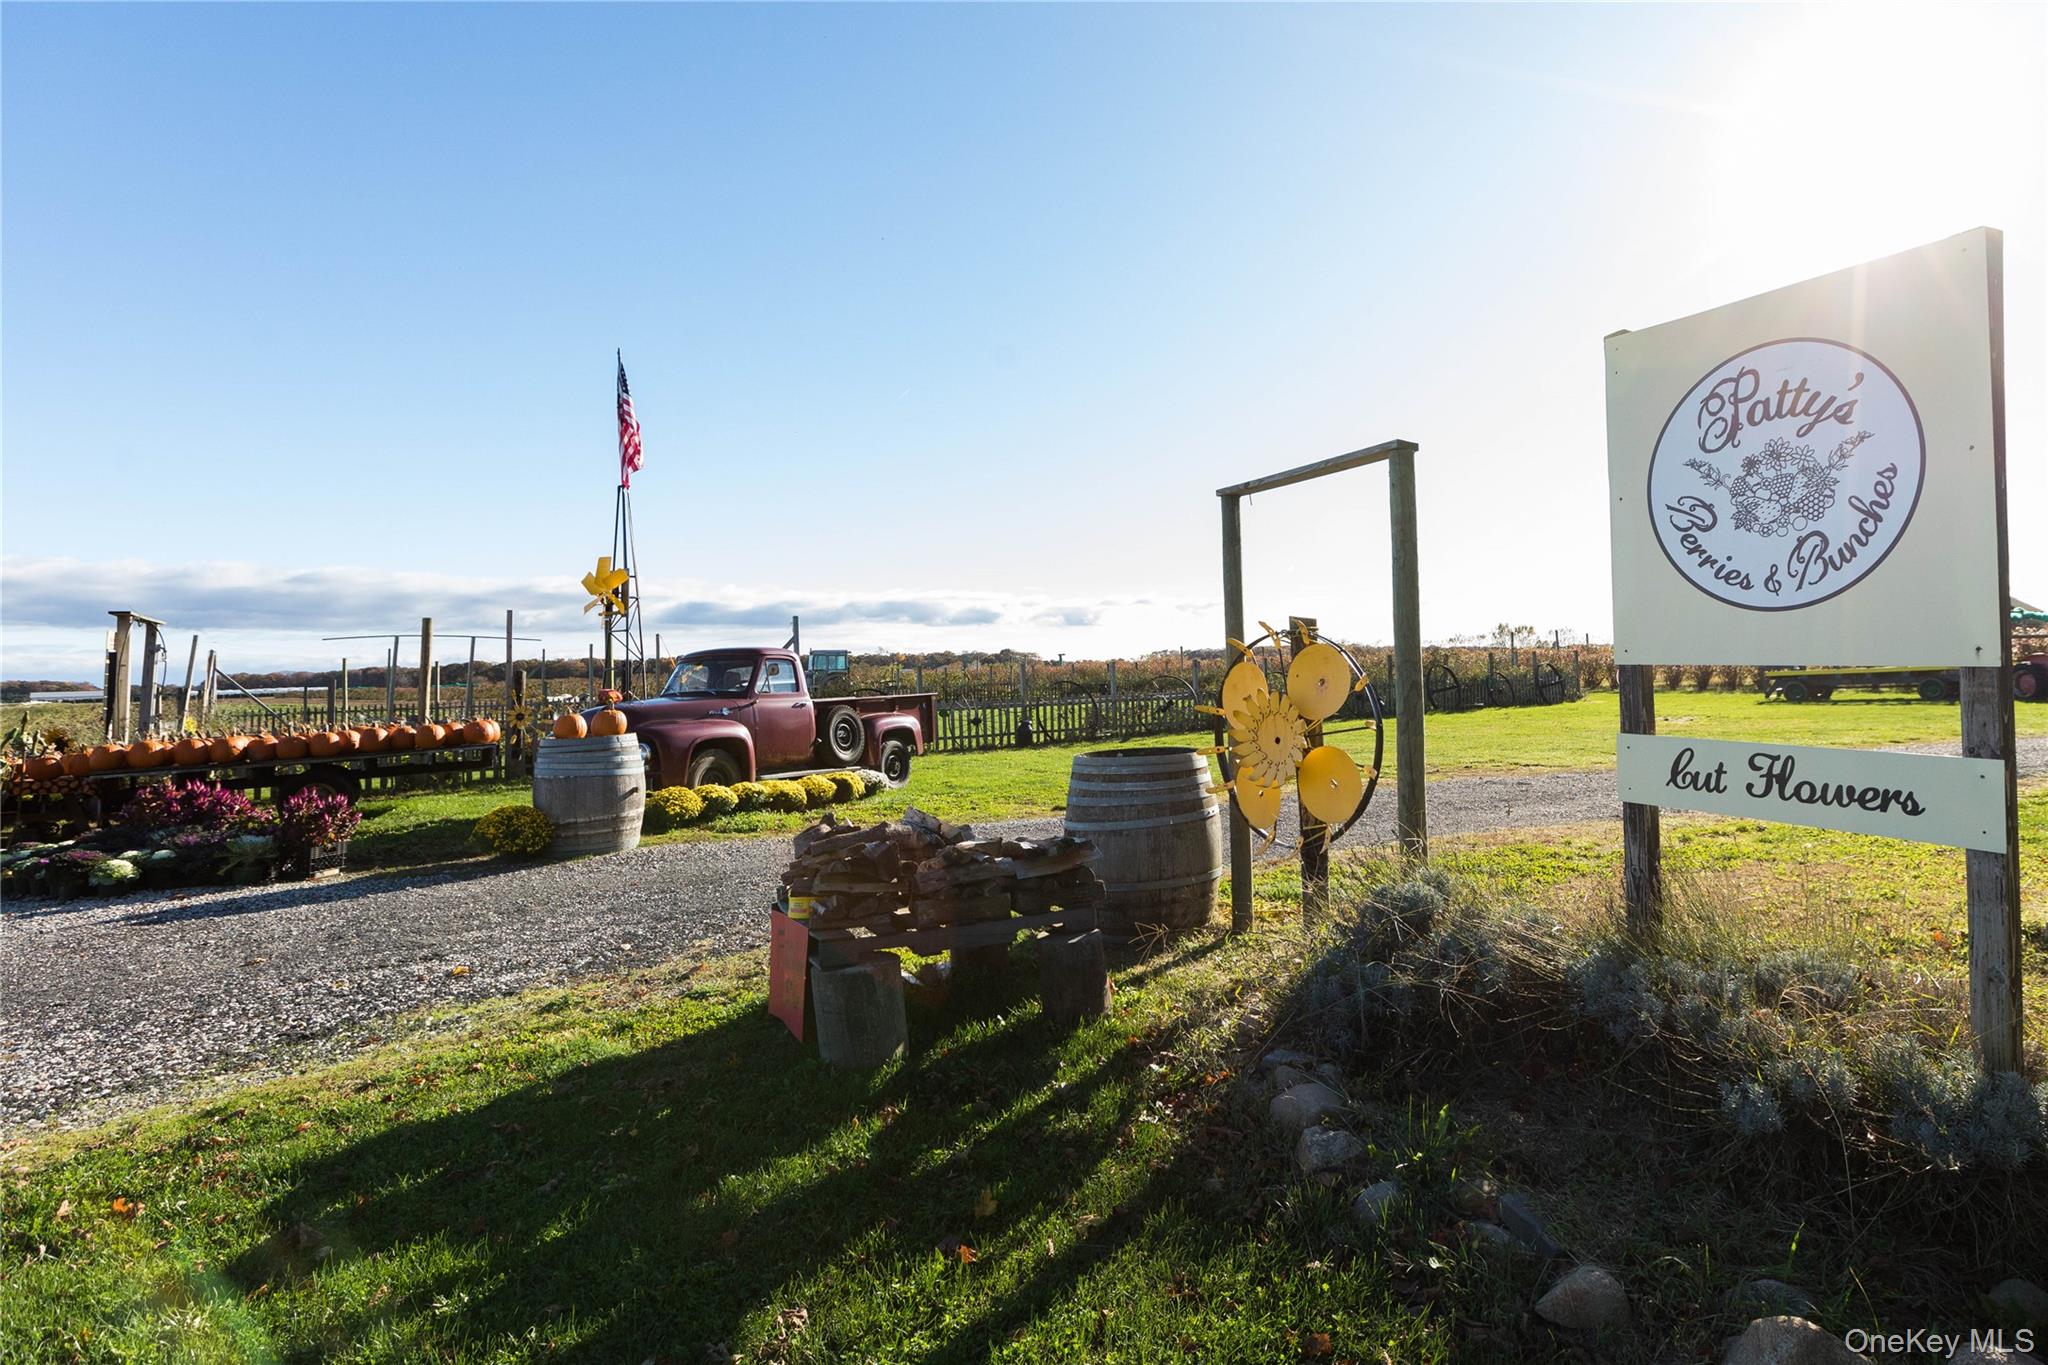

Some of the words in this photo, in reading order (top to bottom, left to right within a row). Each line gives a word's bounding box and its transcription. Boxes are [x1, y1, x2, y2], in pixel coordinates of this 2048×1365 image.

[1665, 495, 1754, 591] Berries
[1764, 564, 1782, 596] &
[1787, 462, 1898, 592] Bunches
[1666, 747, 1727, 794] Cut
[1745, 752, 1926, 816] Flowers
